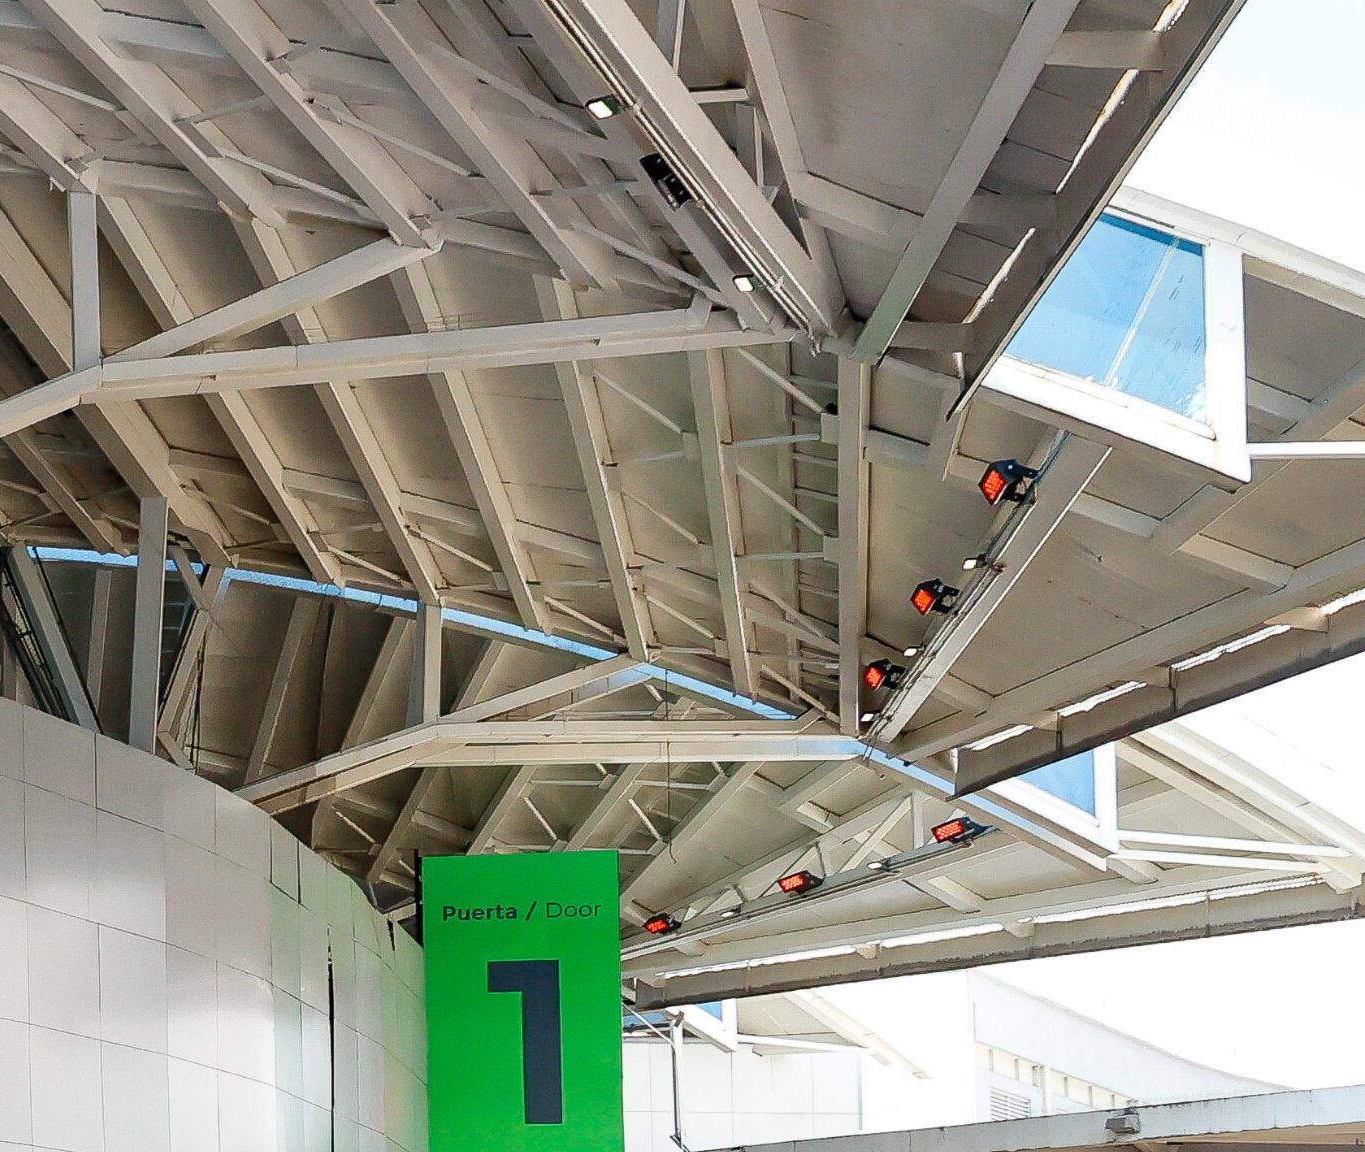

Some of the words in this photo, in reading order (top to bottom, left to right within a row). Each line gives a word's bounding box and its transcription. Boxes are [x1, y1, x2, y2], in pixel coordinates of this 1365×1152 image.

[442, 904, 518, 922] Puerta
[524, 900, 538, 922] /
[545, 901, 602, 919] Door
[487, 959, 563, 1125] 1
